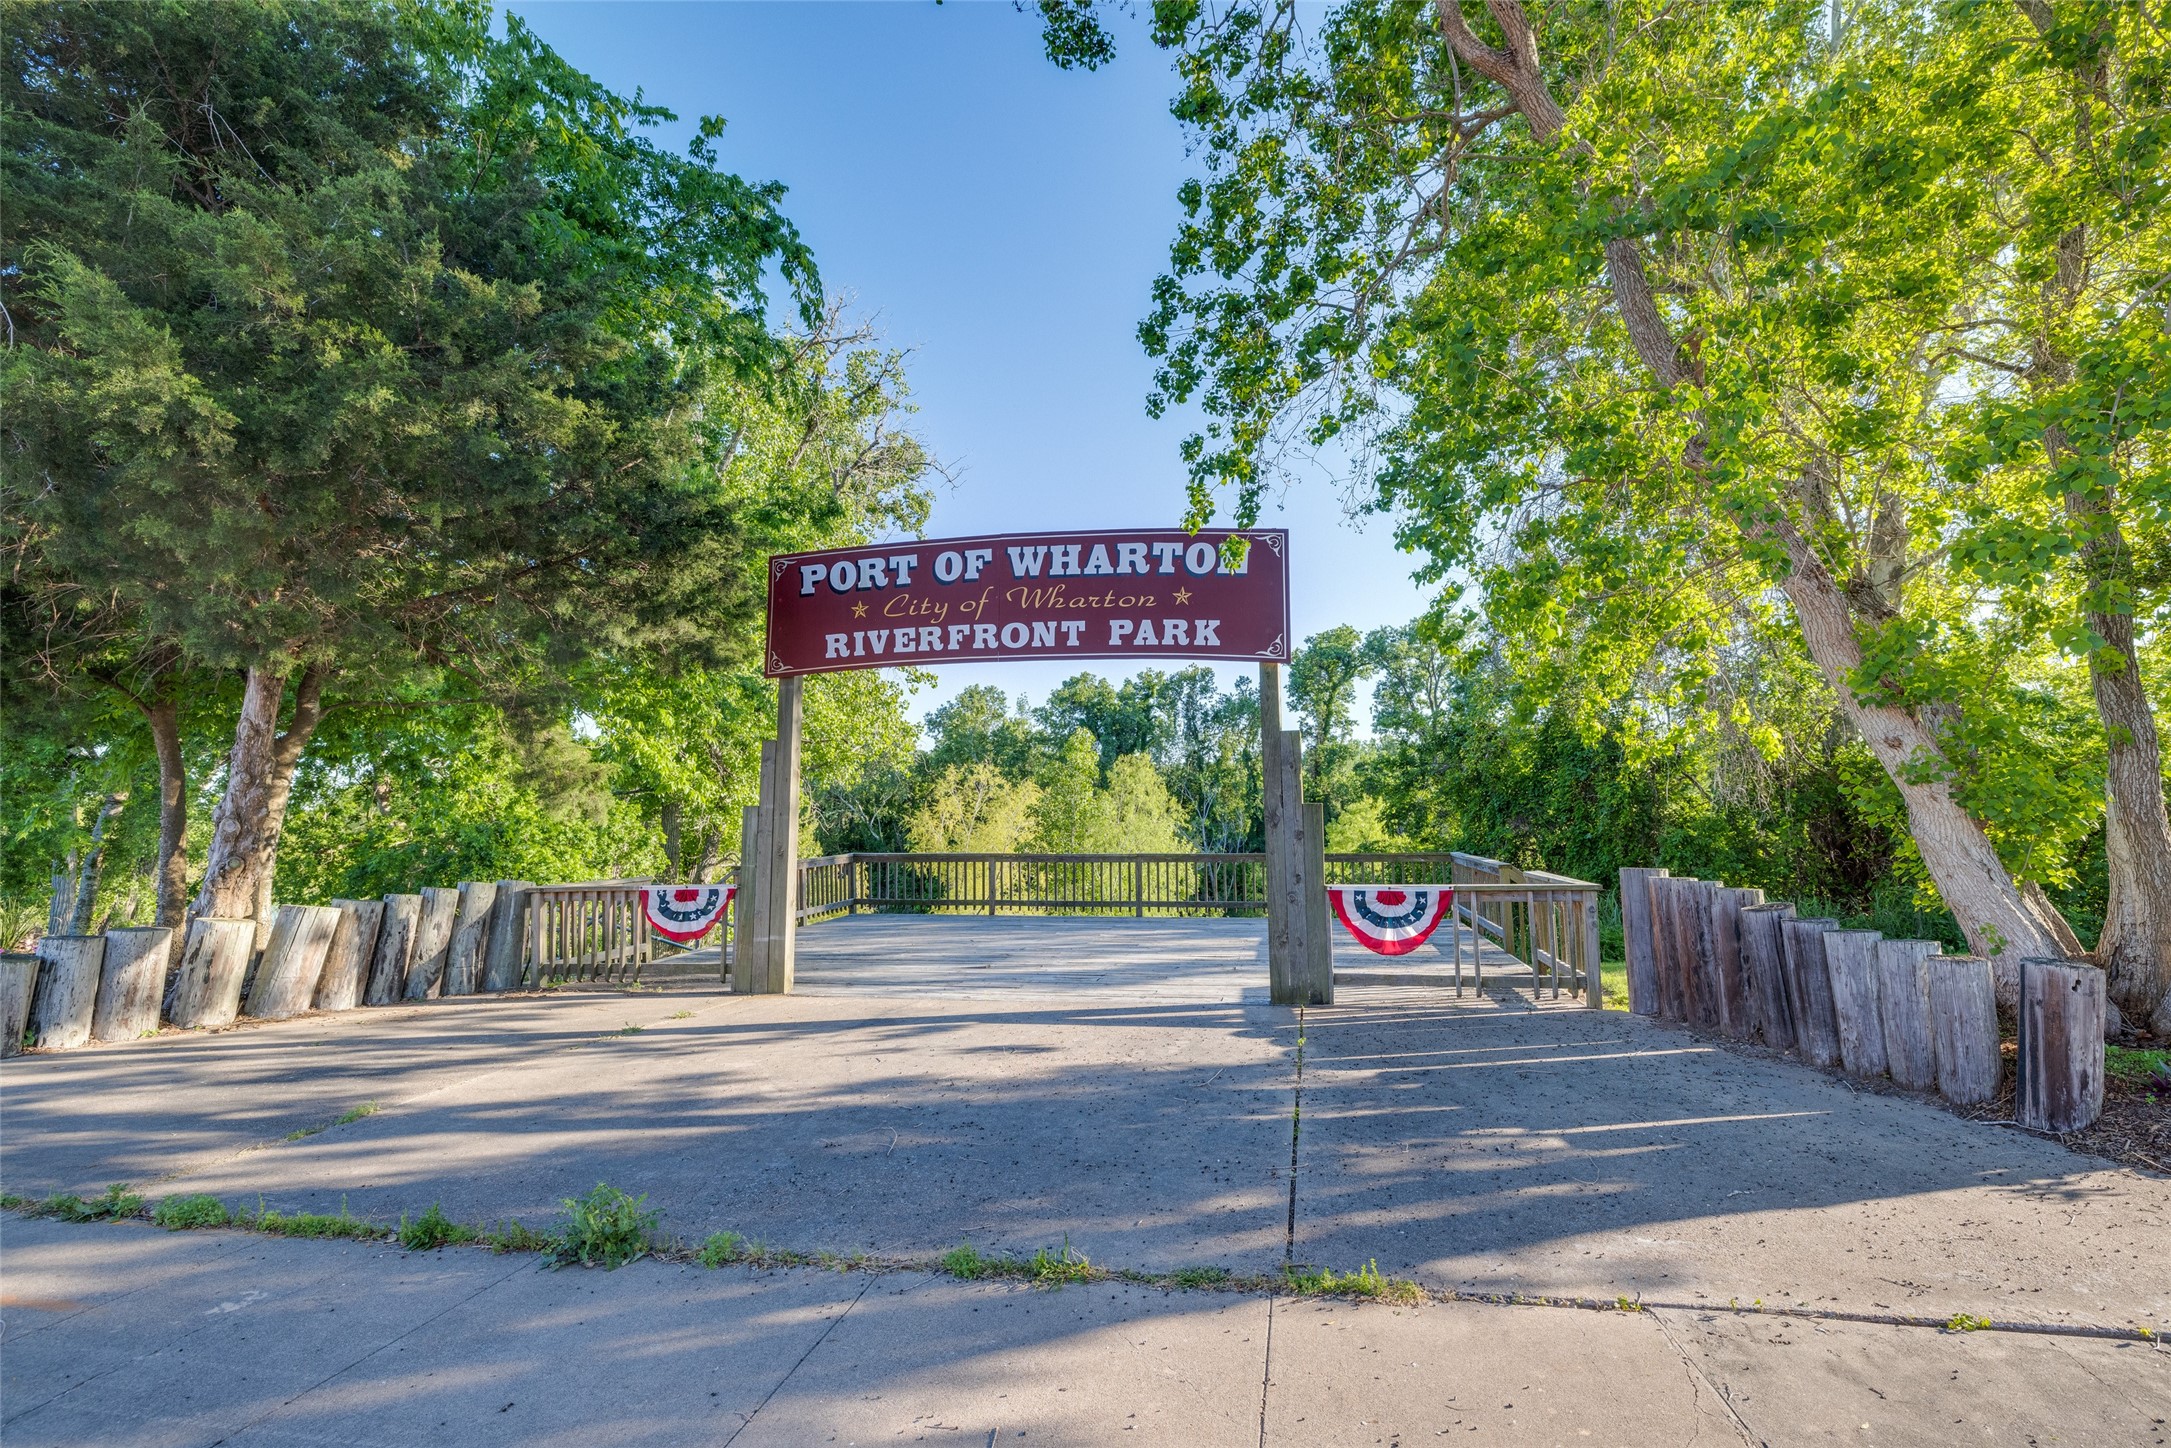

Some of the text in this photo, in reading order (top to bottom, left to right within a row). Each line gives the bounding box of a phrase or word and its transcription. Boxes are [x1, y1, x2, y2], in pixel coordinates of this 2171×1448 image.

[800, 553, 918, 597] PORT
[934, 548, 993, 584] OF
[883, 583, 1157, 624] City of Wharton
[825, 618, 1222, 659] RIVERFRONT PARK
